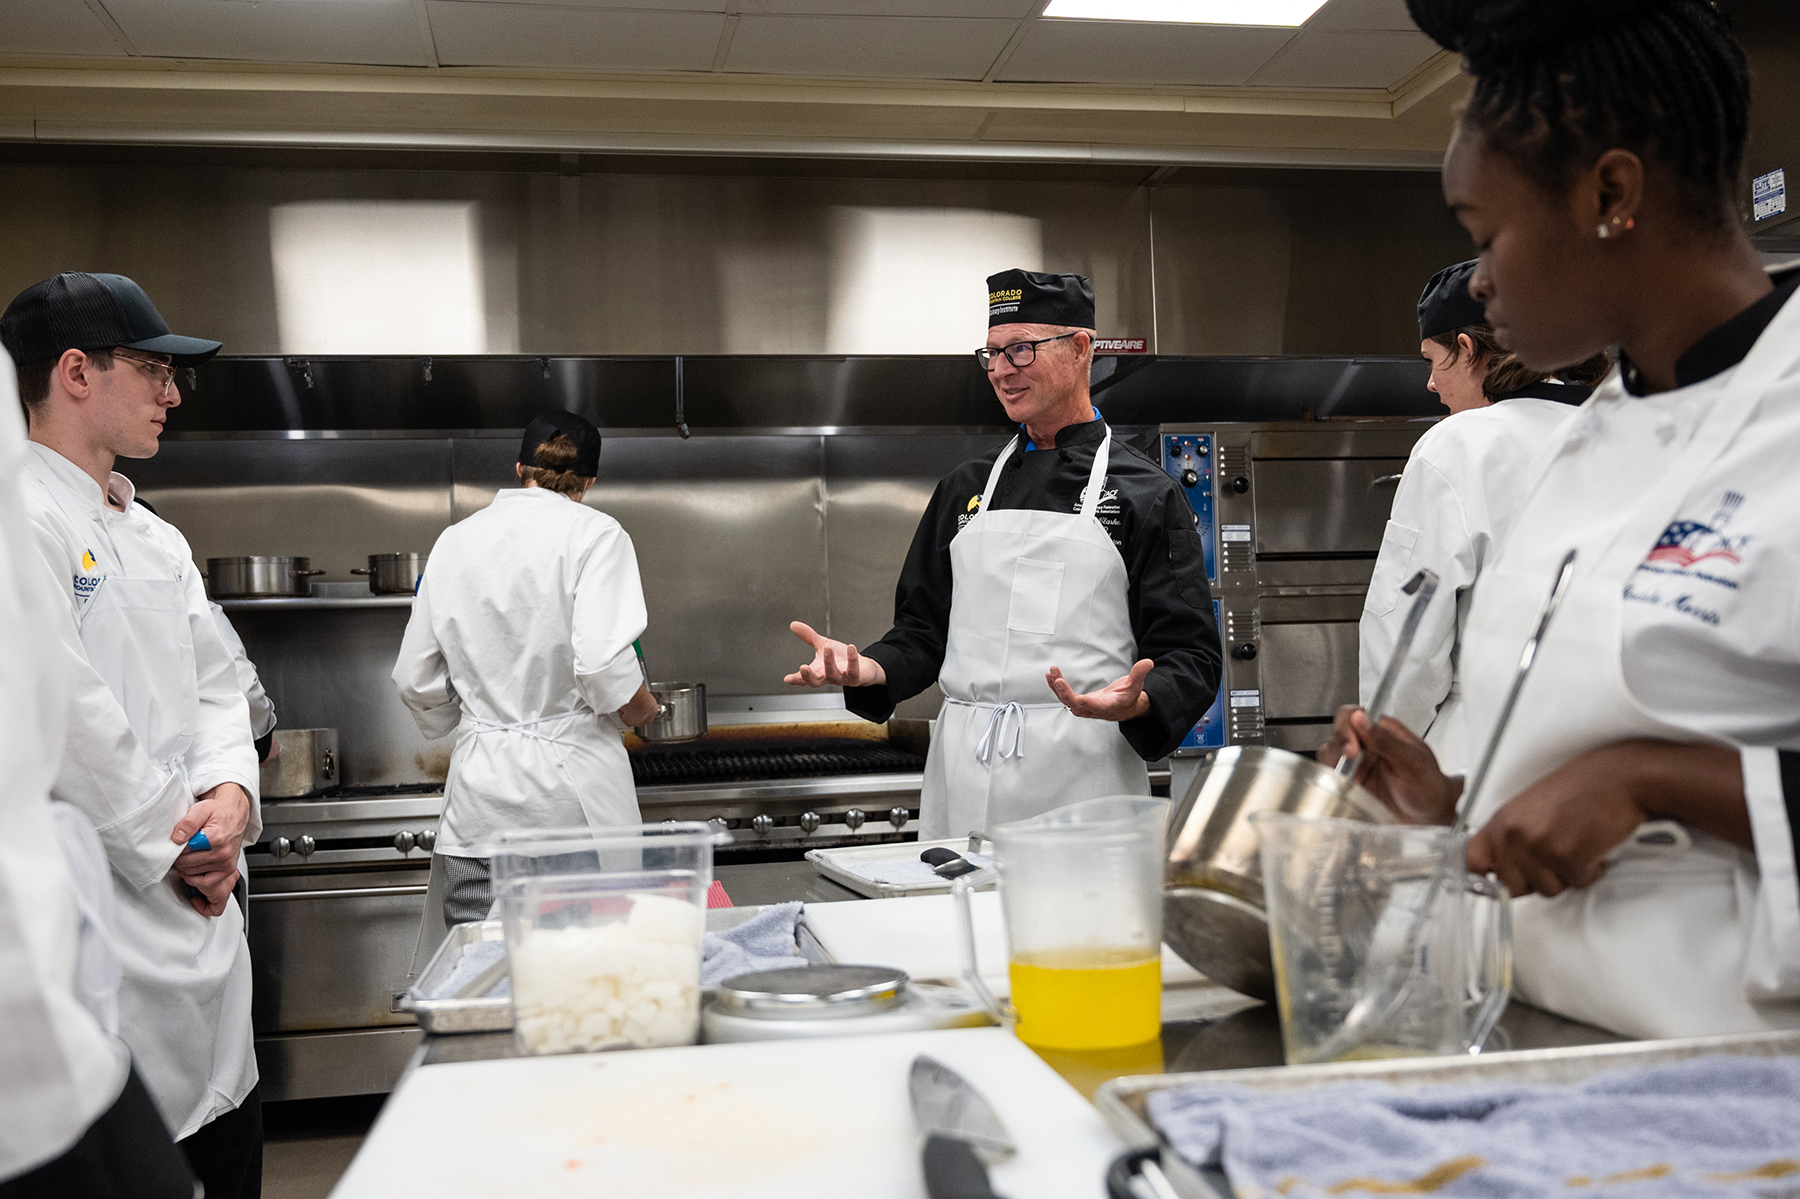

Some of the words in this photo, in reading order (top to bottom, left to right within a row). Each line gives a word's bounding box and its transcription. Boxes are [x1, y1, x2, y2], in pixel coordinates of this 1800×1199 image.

[989, 289, 1023, 299] OLORADO
[1093, 340, 1144, 349] PTIVEAIRE
[74, 575, 100, 586] COLO
